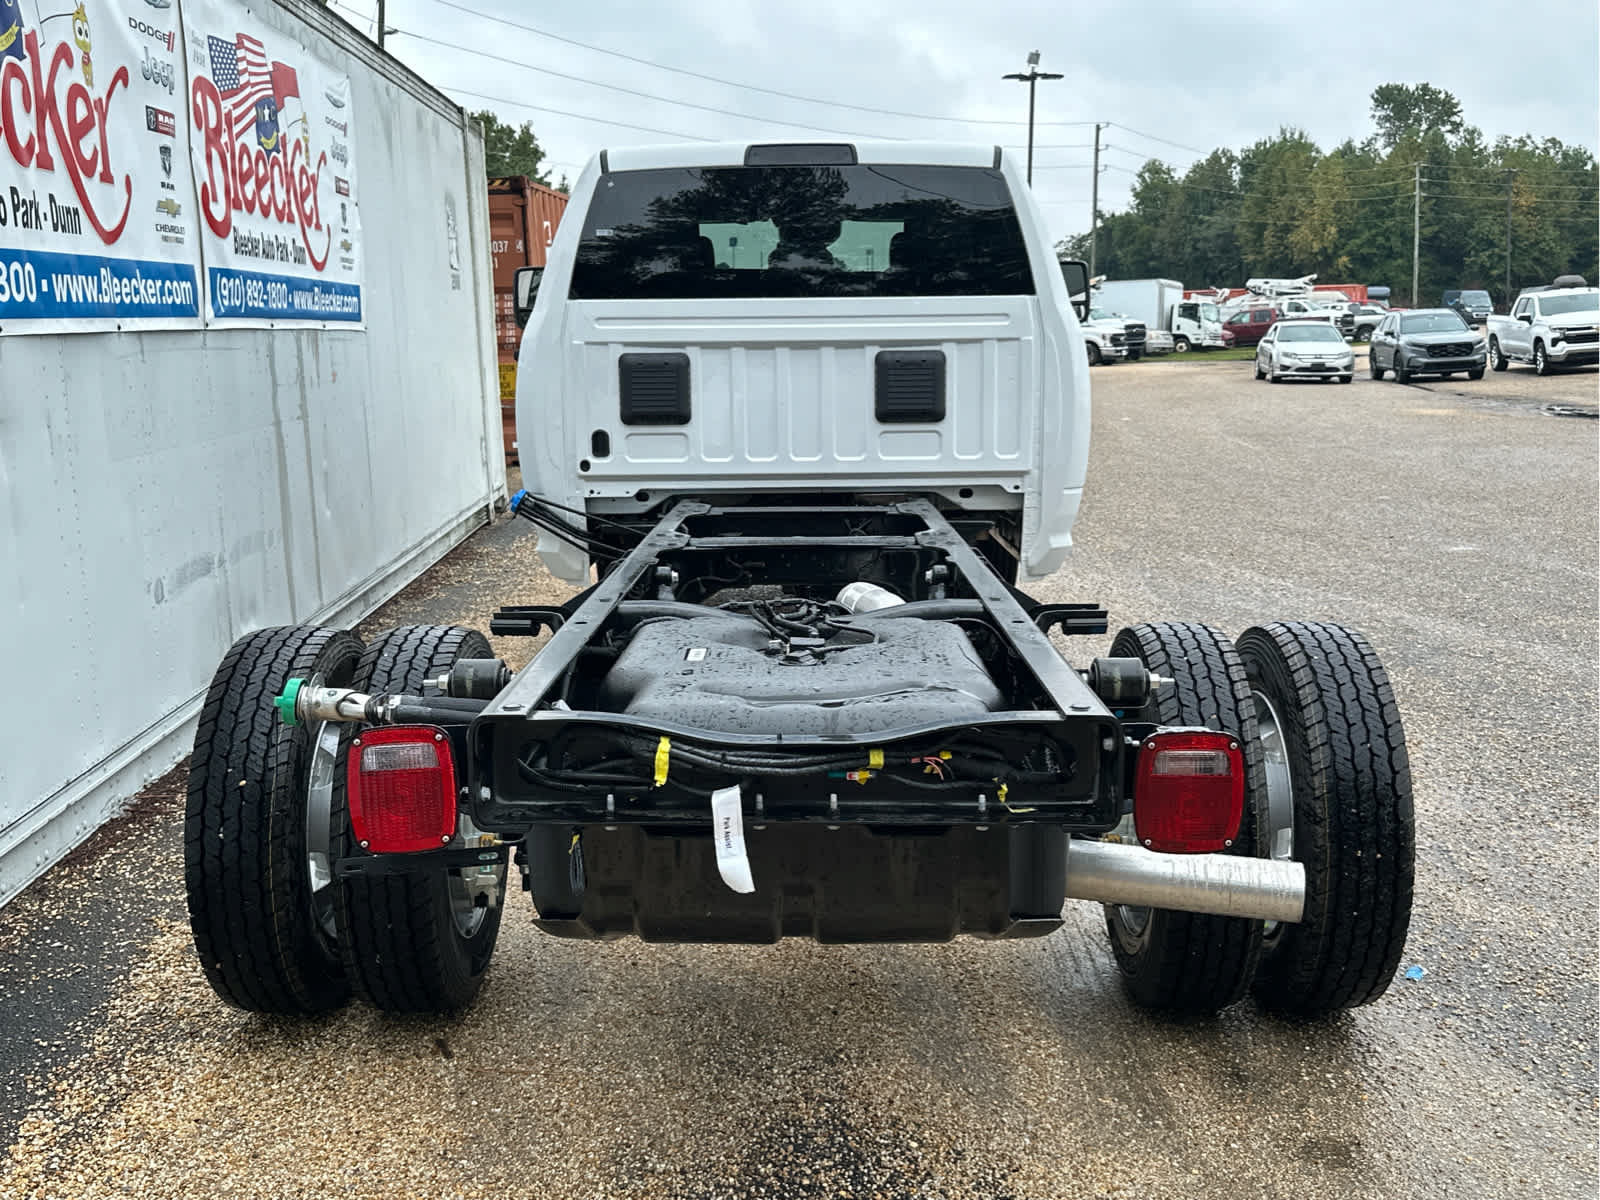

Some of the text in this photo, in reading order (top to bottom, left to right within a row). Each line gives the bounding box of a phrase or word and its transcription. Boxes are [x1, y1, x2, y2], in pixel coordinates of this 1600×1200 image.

[129, 16, 169, 44] DODGE
[141, 46, 175, 96] Jeep
[0, 29, 131, 245] cker
[192, 75, 331, 271] Bleecker
[9, 185, 43, 231] Park
[48, 192, 82, 236] Dunn
[233, 225, 260, 258] Bleecker
[261, 231, 275, 261] Auto
[274, 234, 289, 263] Park
[51, 266, 194, 305] www.Bleecker.com
[216, 272, 246, 313] (910)
[246, 279, 288, 309] 892-1800
[293, 286, 360, 313] www.Bleecker.com
